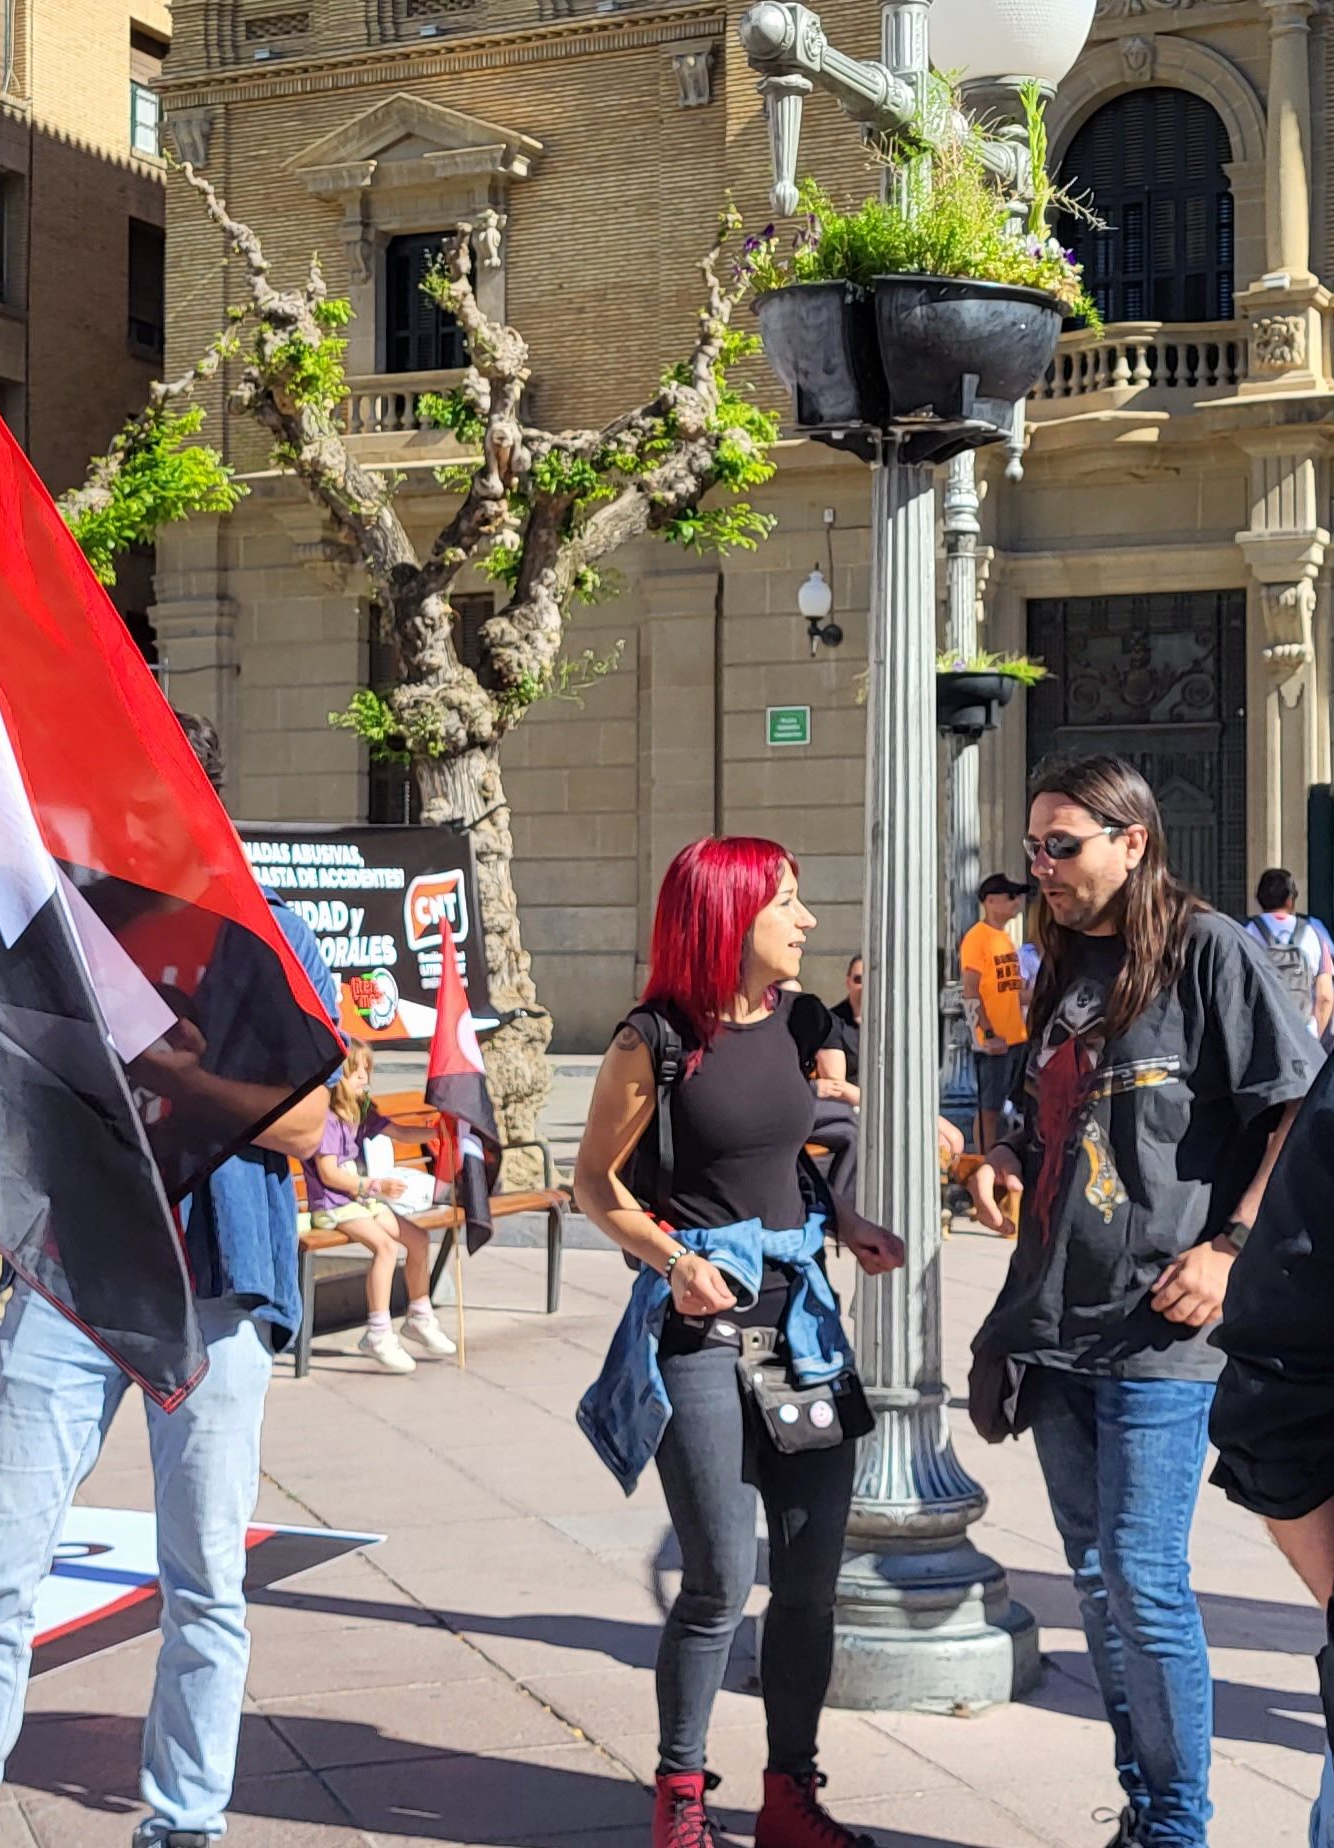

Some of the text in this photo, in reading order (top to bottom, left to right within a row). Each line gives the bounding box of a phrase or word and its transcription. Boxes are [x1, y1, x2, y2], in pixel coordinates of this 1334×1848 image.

[297, 867, 319, 888] DE
[349, 907, 365, 937] y
[413, 892, 457, 925] CNT
[315, 934, 398, 968] ORALES
